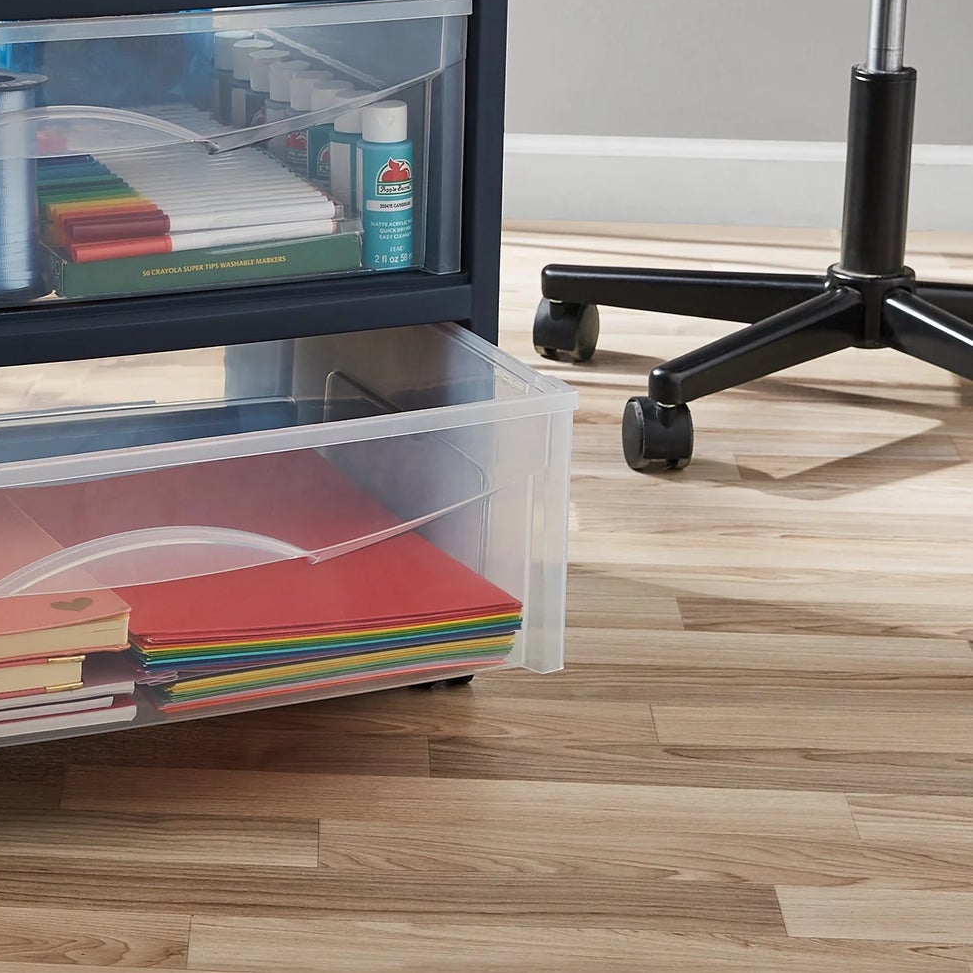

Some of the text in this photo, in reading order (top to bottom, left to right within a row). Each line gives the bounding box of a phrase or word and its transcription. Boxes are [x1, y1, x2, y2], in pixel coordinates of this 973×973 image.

[151, 267, 183, 276] CRAYOLA
[183, 264, 204, 273] SUPER
[205, 262, 219, 271] TIPS
[220, 259, 255, 269] WASHABLE
[255, 255, 287, 265] MARKERS
[374, 254, 380, 263] 2
[381, 254, 388, 263] fl
